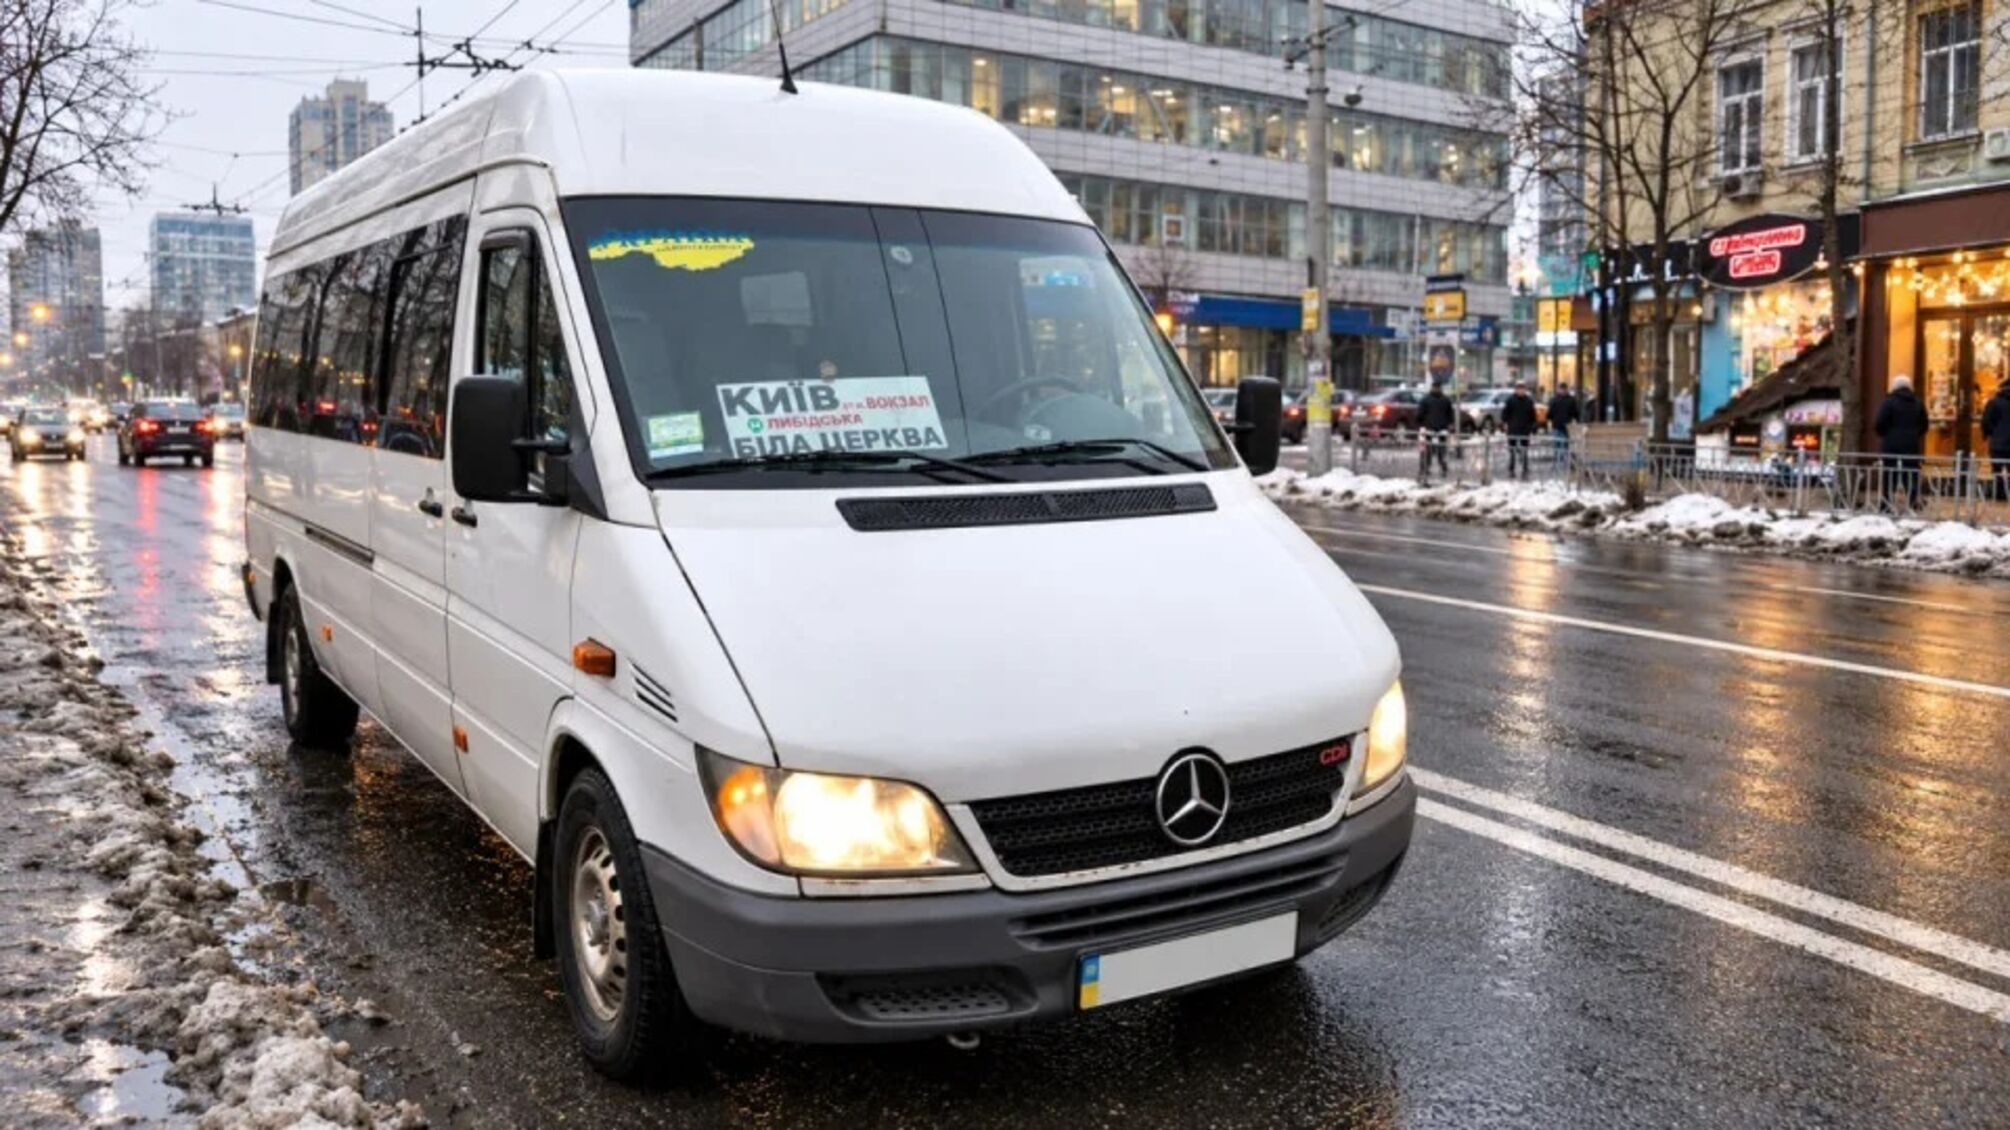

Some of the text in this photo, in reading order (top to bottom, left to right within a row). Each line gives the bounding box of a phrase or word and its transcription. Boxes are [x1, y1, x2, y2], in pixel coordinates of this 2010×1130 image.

[721, 381, 929, 417] КИЇВ ВОКЗАЛ
[767, 413, 863, 430] ЛИБІДСЬКА
[733, 426, 943, 459] БІЛА ЦЕРКВА
[1320, 744, 1347, 765] CDI
